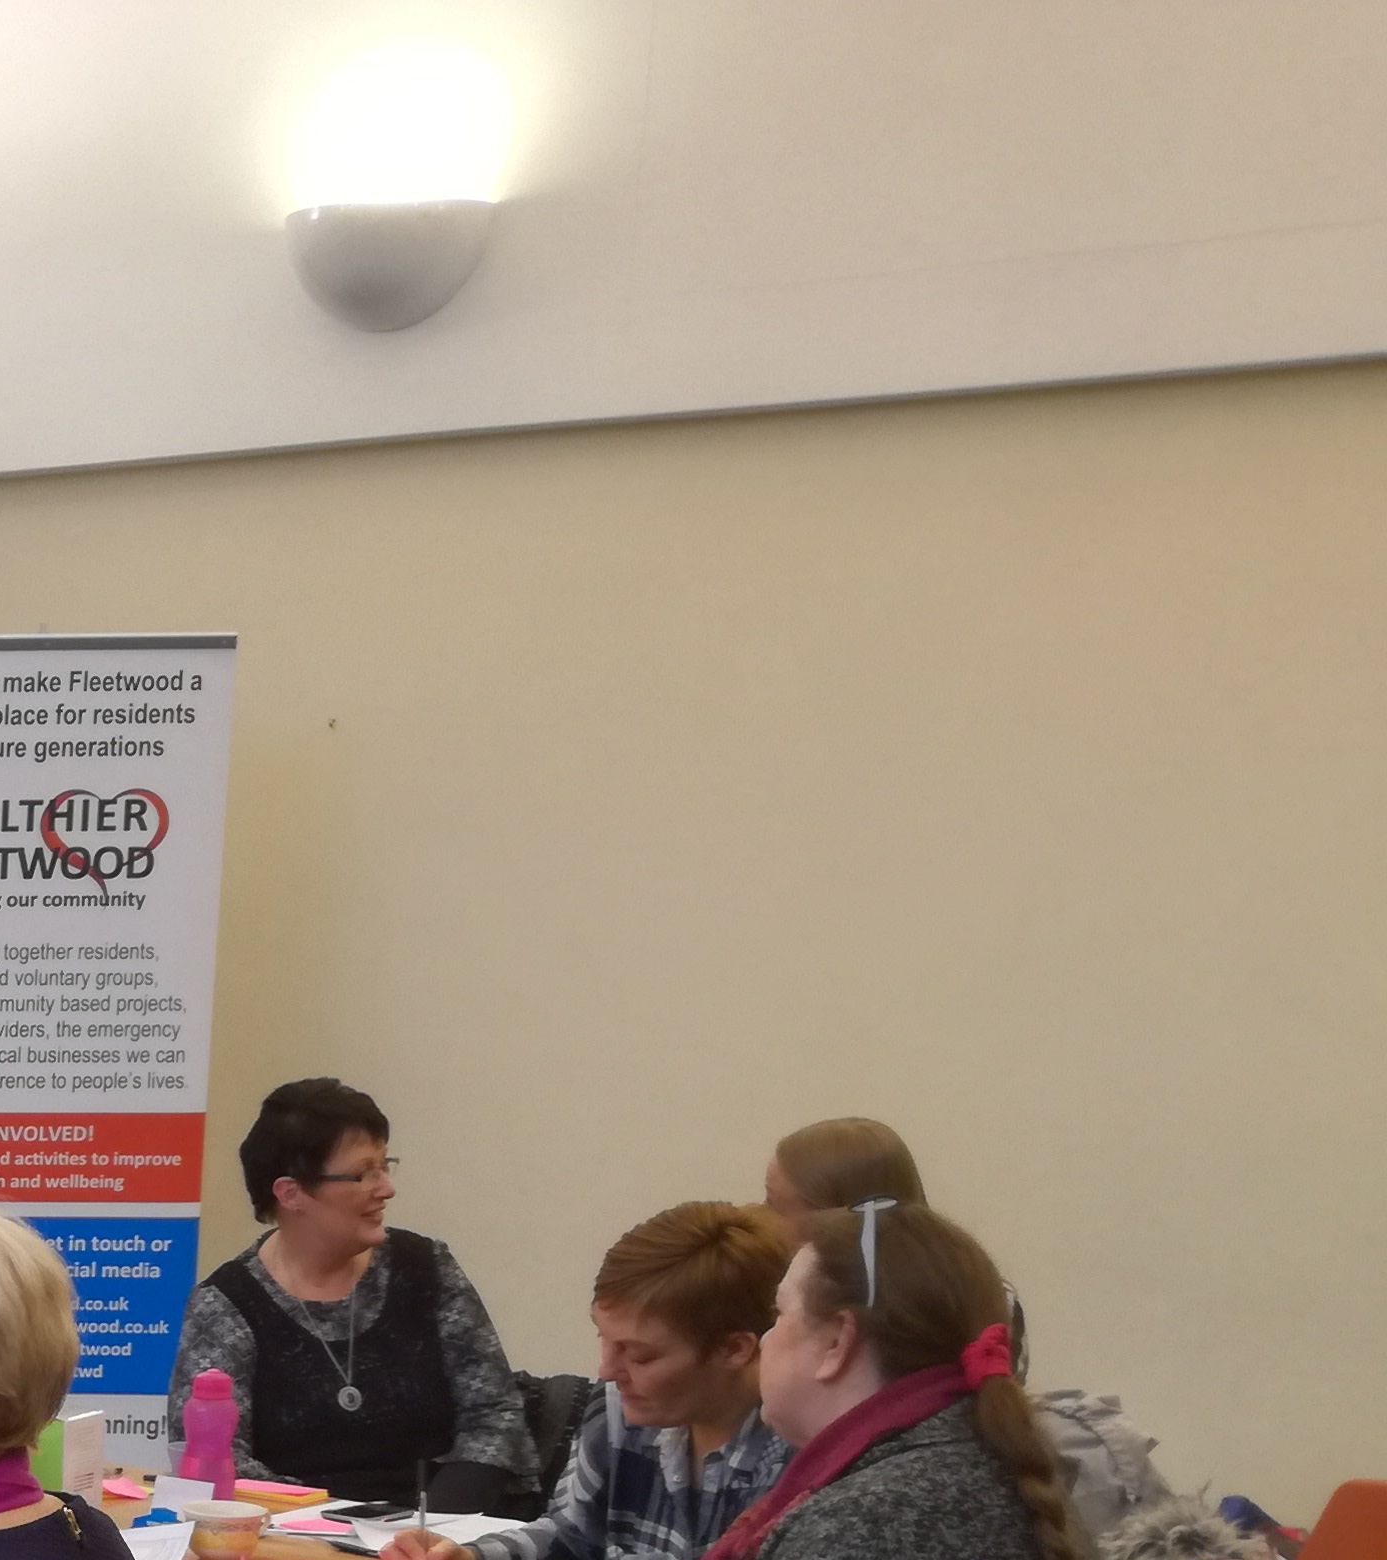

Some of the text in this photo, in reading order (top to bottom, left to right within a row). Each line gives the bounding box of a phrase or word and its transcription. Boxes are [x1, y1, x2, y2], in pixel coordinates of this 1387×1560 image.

[3, 671, 61, 693] make
[69, 670, 184, 692] Fleetwood
[191, 674, 202, 691] a
[56, 705, 86, 725] for
[94, 704, 195, 724] residents
[35, 736, 164, 761] generations
[7, 894, 38, 908] our
[43, 891, 146, 910] community
[4, 943, 73, 964] together
[78, 943, 160, 962] residents,
[15, 969, 90, 989] voluntary
[96, 971, 158, 990] groups,
[60, 996, 110, 1012] based
[116, 996, 186, 1015] projects,
[57, 1021, 81, 1037] the
[87, 1024, 180, 1041] emergency
[27, 1047, 120, 1063] businesses
[127, 1051, 150, 1063] we
[156, 1051, 185, 1063] can
[51, 1074, 66, 1088] to
[72, 1072, 141, 1092] people's
[14, 1151, 87, 1166] activities
[92, 1152, 109, 1165] to
[114, 1152, 182, 1168] improve
[10, 1174, 40, 1188] and
[46, 1174, 124, 1192] wellbeing
[69, 1235, 86, 1251] in
[92, 1235, 145, 1252] touch
[151, 1239, 172, 1252] or
[67, 1262, 161, 1278] cial media
[76, 1319, 169, 1334] wood.co.uk
[80, 1342, 132, 1356] twood
[74, 1364, 103, 1378] twd
[106, 1415, 166, 1440] nning!
